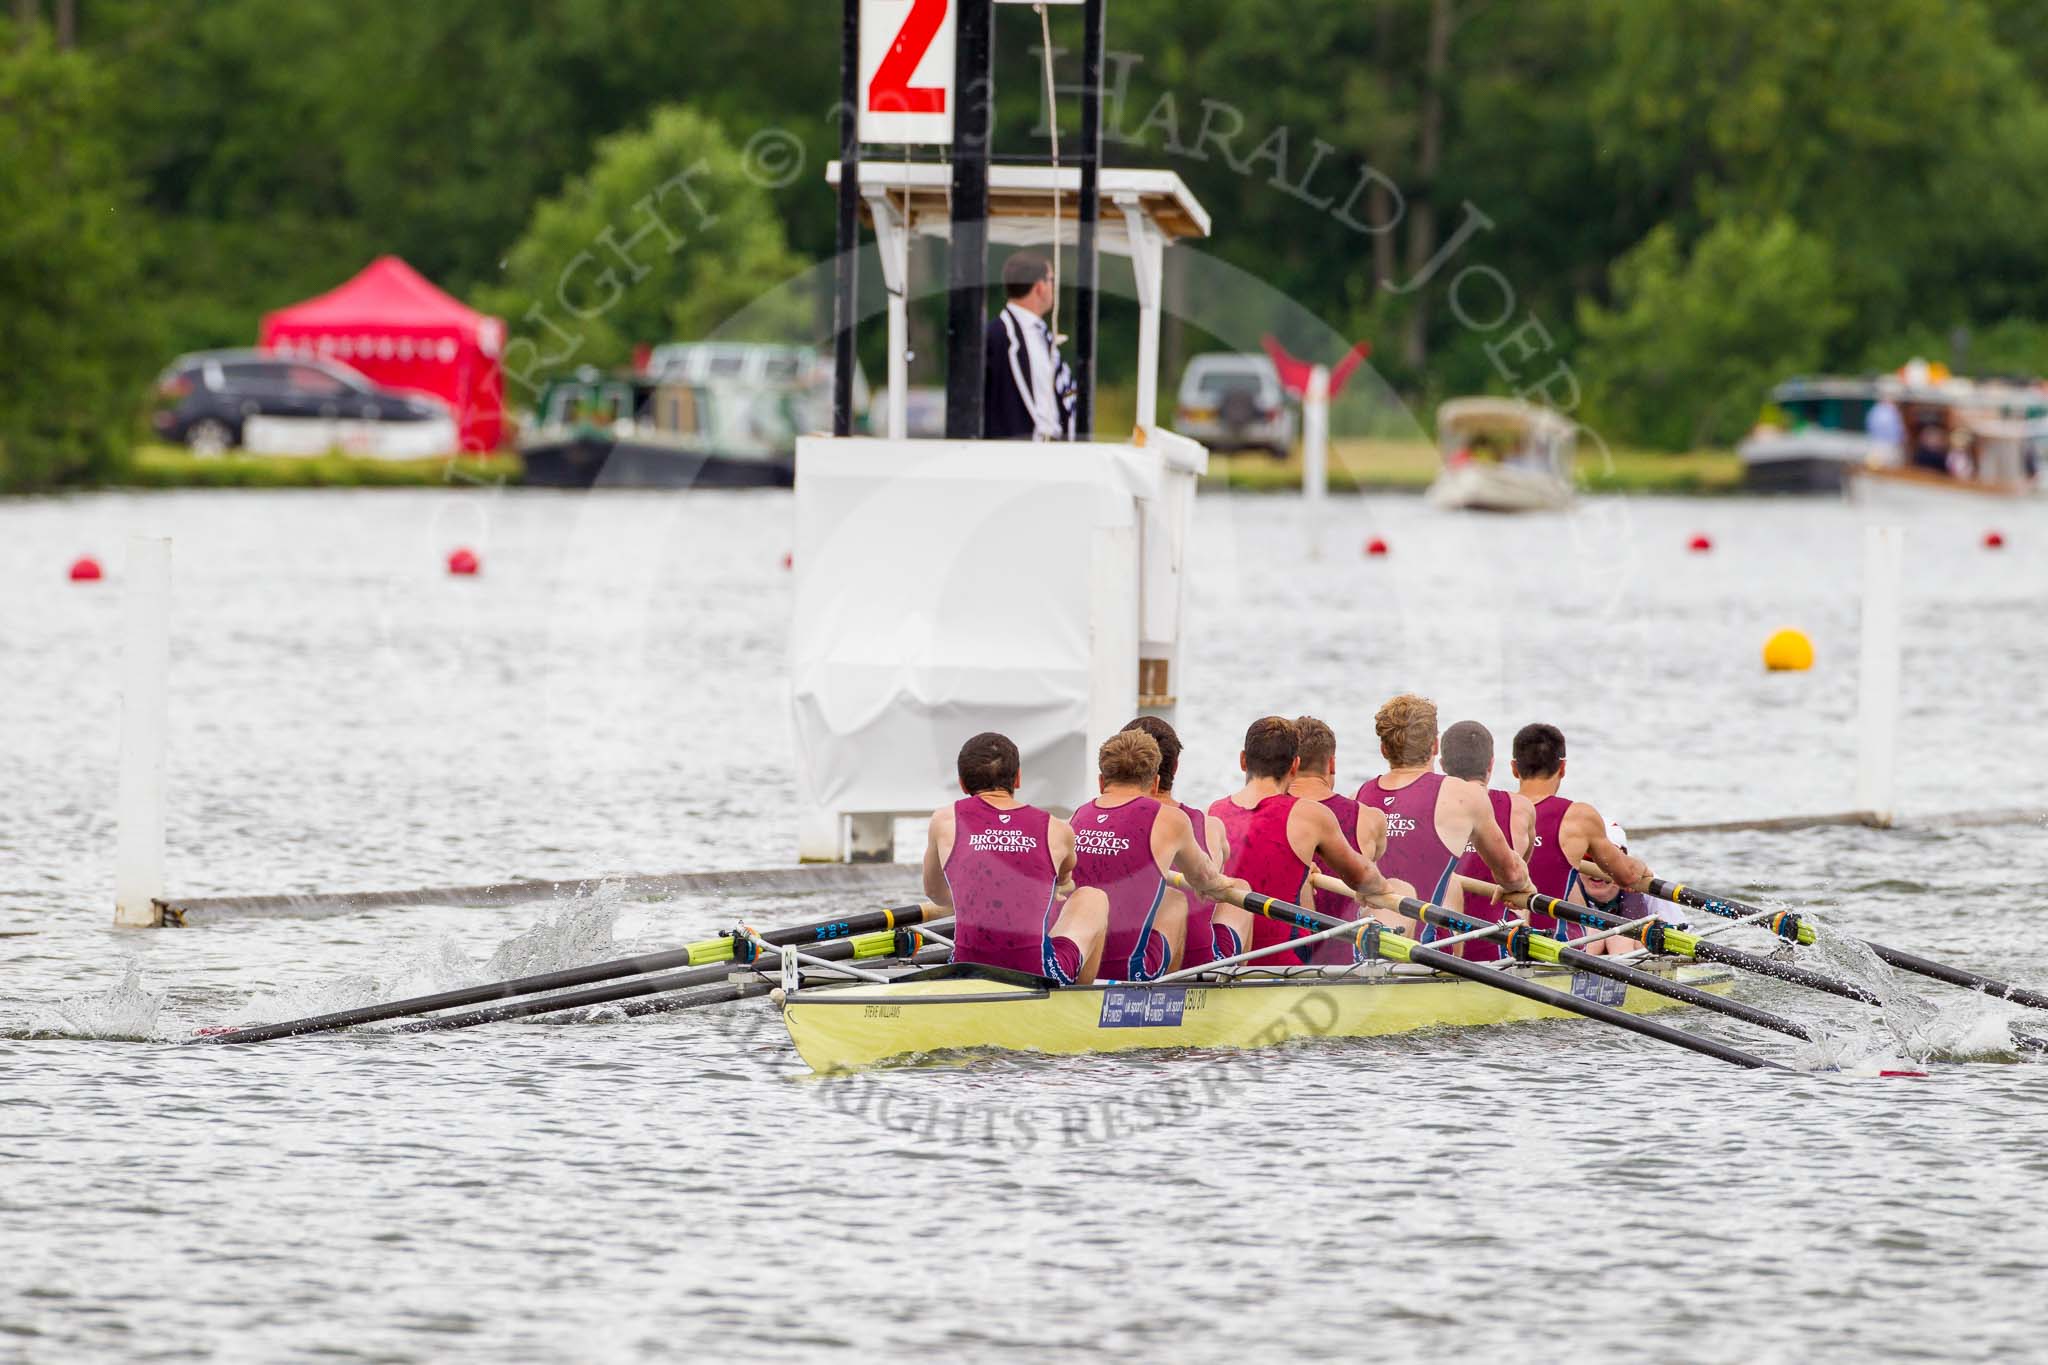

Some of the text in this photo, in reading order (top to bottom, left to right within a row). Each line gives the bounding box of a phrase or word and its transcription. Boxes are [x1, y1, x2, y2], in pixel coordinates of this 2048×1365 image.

[868, 0, 948, 114] 2
[984, 828, 1023, 837] OXFORD
[1079, 829, 1115, 838] OXFORD
[968, 834, 1037, 848] BROOKES
[1074, 835, 1130, 850] OOKES
[974, 844, 1030, 853] UNIVERSITY
[1074, 845, 1119, 856] IVERSITY
